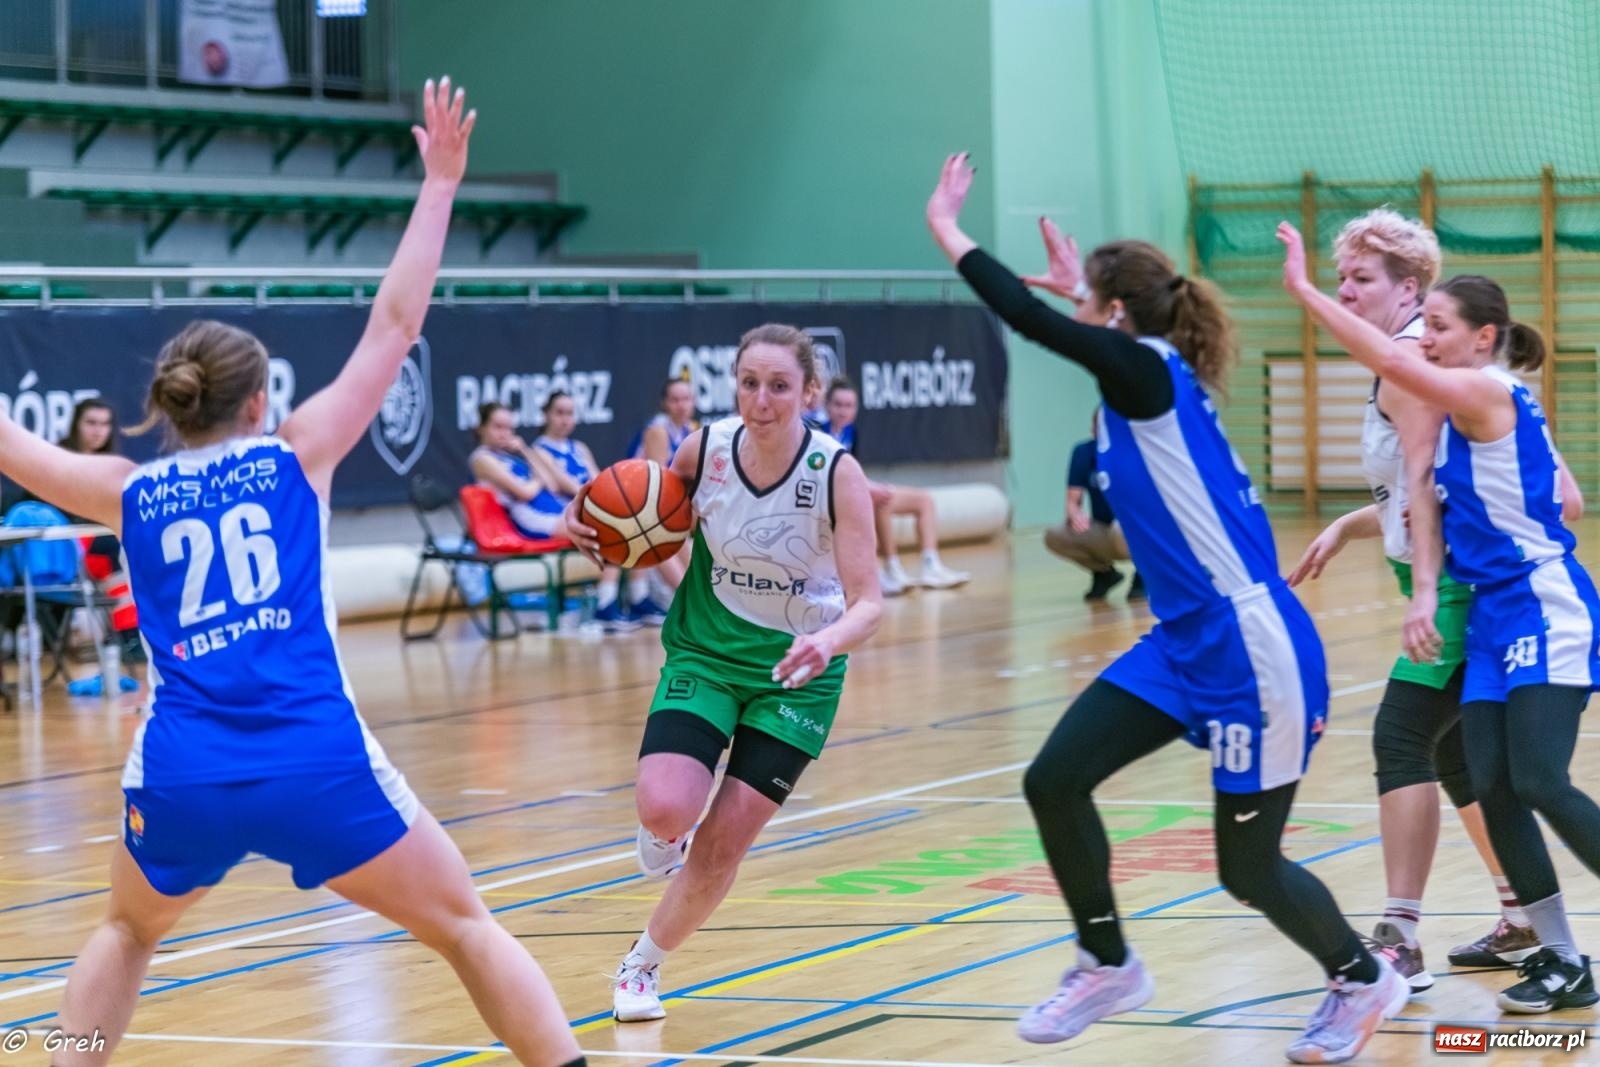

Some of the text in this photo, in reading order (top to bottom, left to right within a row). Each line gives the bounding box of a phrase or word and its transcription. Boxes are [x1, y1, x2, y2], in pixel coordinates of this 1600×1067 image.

[862, 345, 976, 409] RACIBÓRZ
[138, 458, 277, 506] MKS MOS
[795, 479, 817, 509] 9
[161, 502, 281, 628] 26
[191, 607, 291, 657] BETARD
[665, 676, 697, 700] 9
